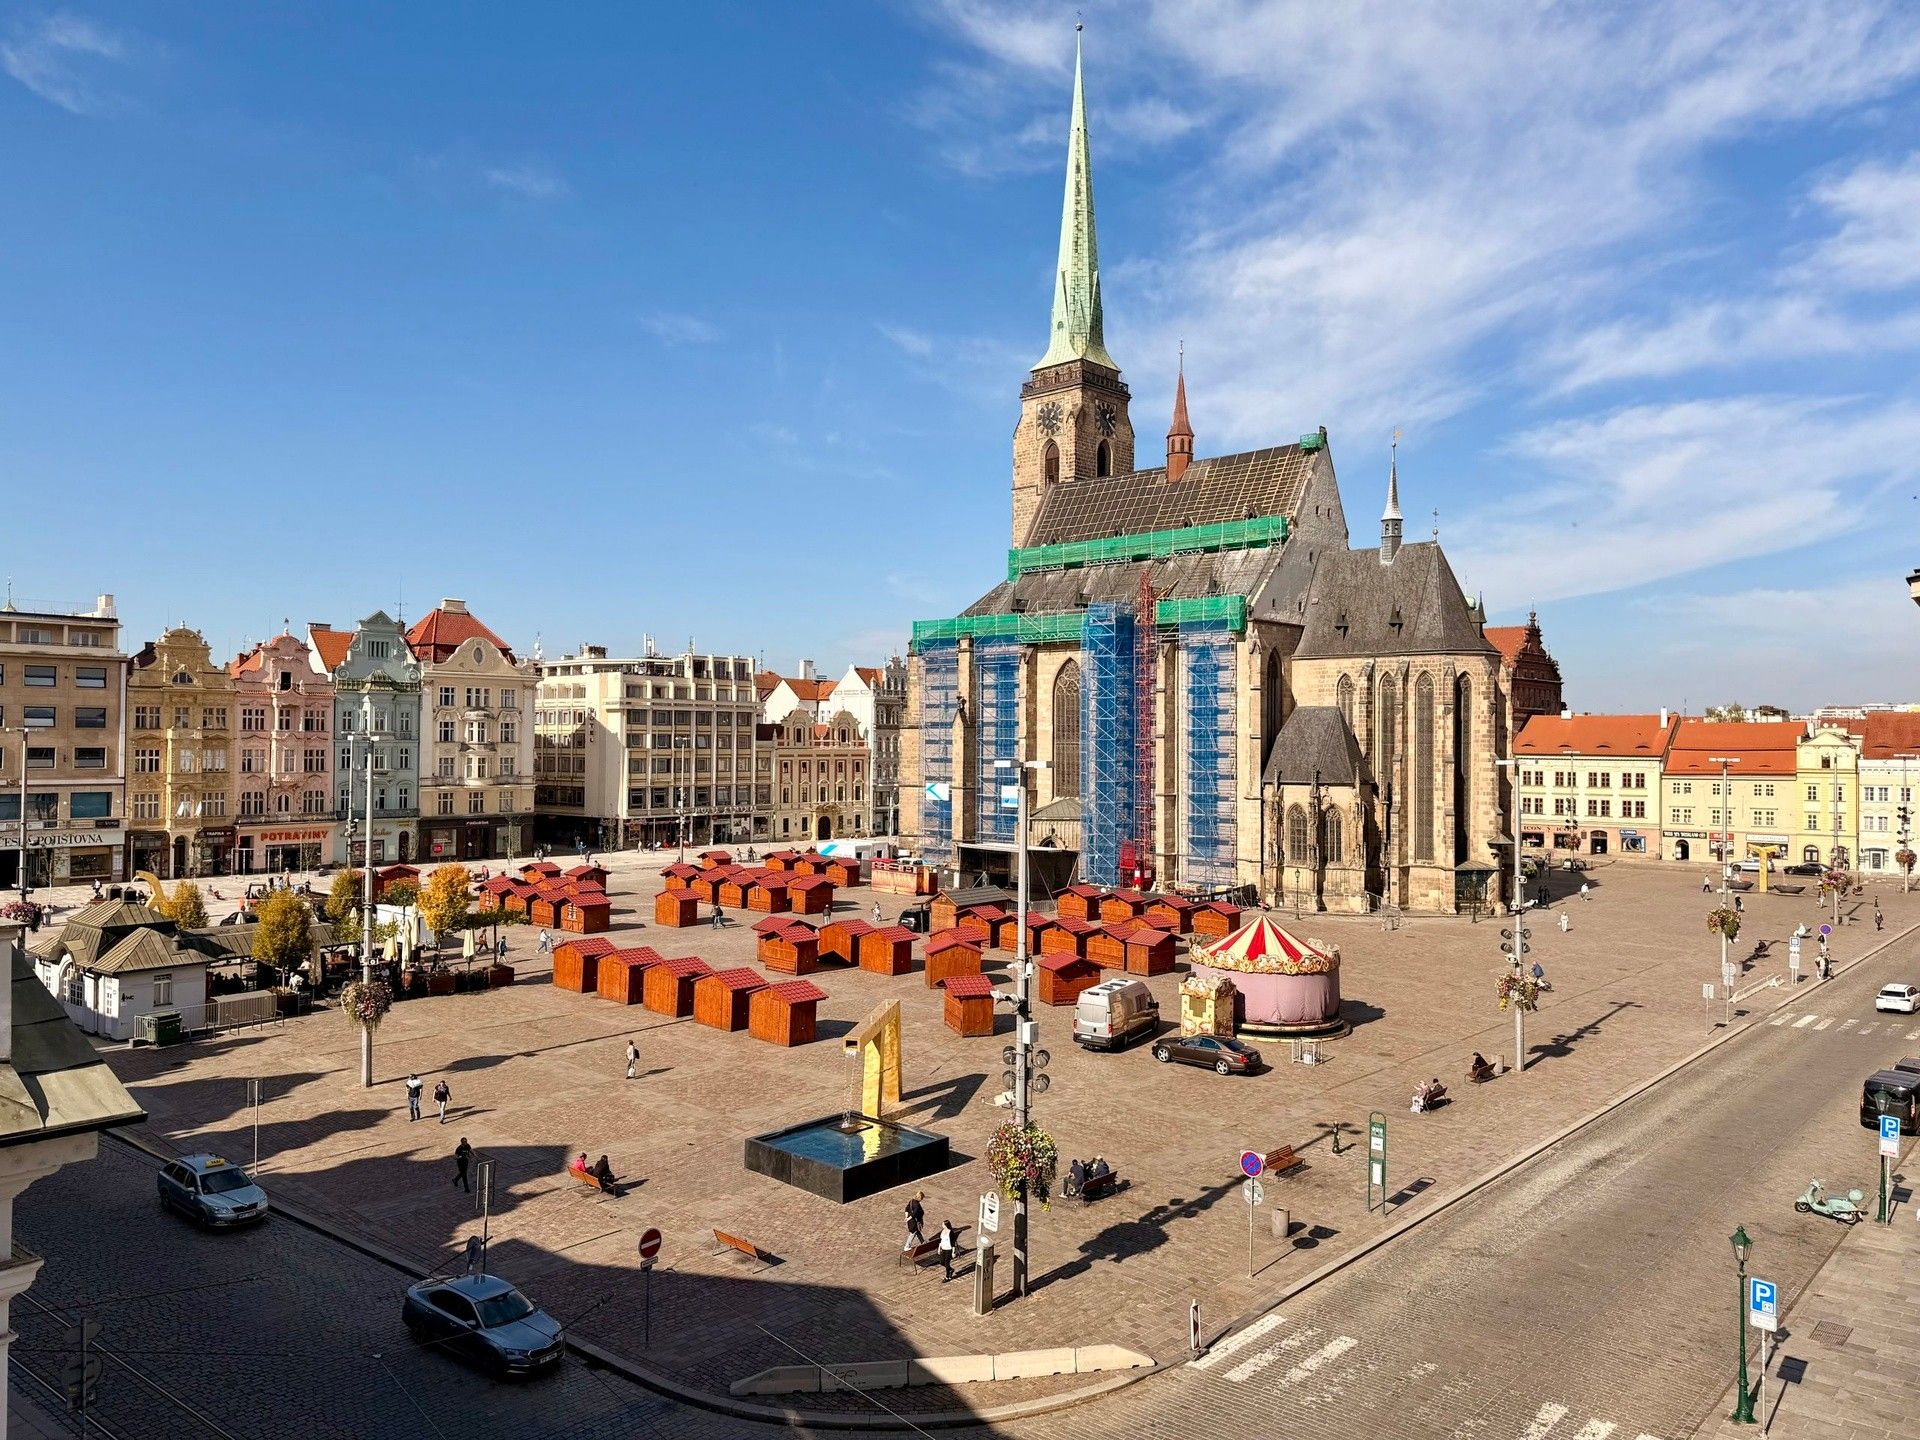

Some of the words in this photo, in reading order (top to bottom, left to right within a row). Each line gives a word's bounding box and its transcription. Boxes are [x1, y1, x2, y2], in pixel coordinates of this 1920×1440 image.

[261, 831, 329, 841] POTRAVINY
[1885, 1119, 1897, 1132] P
[1755, 1283, 1771, 1303] P
